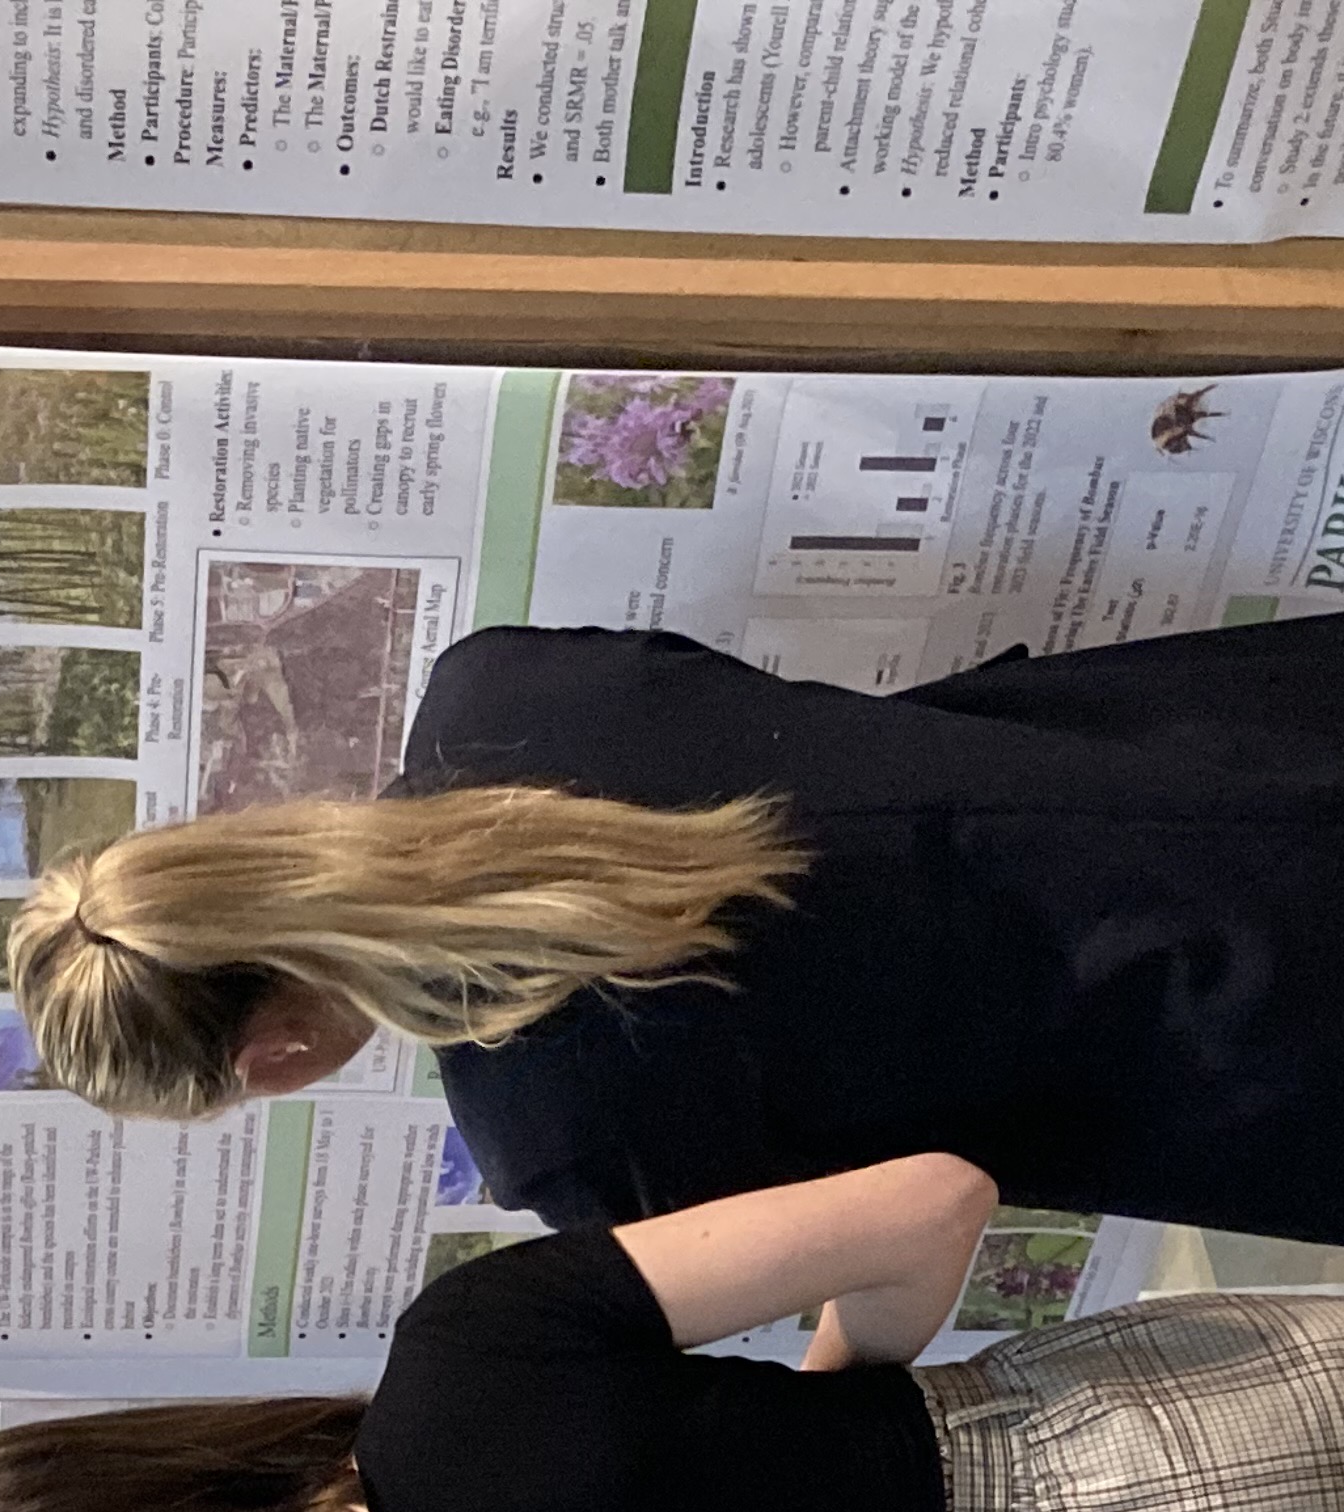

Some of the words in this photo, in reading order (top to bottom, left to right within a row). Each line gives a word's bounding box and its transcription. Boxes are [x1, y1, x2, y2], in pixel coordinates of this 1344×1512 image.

[11, 31, 27, 46] to
[43, 26, 61, 36] It
[45, 8, 62, 20] is
[413, 28, 428, 42] to
[607, 23, 626, 52] talk
[731, 4, 756, 53] shown
[899, 5, 920, 28] the
[75, 20, 96, 102] disordered
[407, 47, 427, 75] like
[478, 50, 494, 74] am
[896, 31, 914, 49] of
[919, 52, 940, 76] We
[9, 52, 32, 137] expanding
[536, 42, 560, 125] conducted
[564, 66, 588, 123] SRMR
[602, 56, 621, 114] mother
[725, 59, 745, 84] has
[887, 54, 909, 101] model
[206, 71, 227, 167] Measures:
[239, 48, 262, 147] Predictors:
[272, 95, 291, 127] The
[305, 96, 324, 129] The
[336, 55, 361, 152] Outcomes:
[369, 78, 391, 132] Dutch
[405, 80, 423, 133] would
[435, 75, 461, 134] Eating
[747, 73, 776, 170] adolescents
[778, 72, 810, 150] However,
[814, 56, 843, 153] parent-child
[840, 78, 872, 173] Attachment
[857, 26, 887, 73] theory
[934, 112, 958, 177] reduced
[948, 37, 978, 107] relational
[1018, 125, 1042, 161] Intro
[1033, 34, 1071, 119] psychology
[76, 108, 93, 139] and
[107, 89, 126, 162] Method
[496, 109, 517, 180] Results
[529, 131, 548, 160] We
[563, 129, 581, 162] and
[593, 120, 614, 162] Both
[685, 71, 715, 187] Introduction
[713, 89, 740, 168] Research
[873, 105, 901, 174] working
[1045, 114, 1072, 162] 80.4%
[958, 128, 986, 197] Method
[239, 382, 260, 434] invasive
[293, 408, 310, 450] native
[320, 416, 336, 435] for
[375, 401, 391, 414] in
[401, 399, 417, 442] recruit
[426, 383, 447, 428] flowers
[375, 419, 392, 450] gaps
[398, 447, 412, 460] to
[424, 433, 445, 476] spring
[154, 444, 171, 480] Phase
[209, 438, 228, 522] Restoration
[235, 439, 260, 511] Removing
[287, 455, 311, 513] Planting
[318, 441, 336, 514] vegetation
[340, 439, 361, 515] pollinators
[366, 455, 390, 515] Creating
[264, 463, 282, 513] species
[396, 466, 415, 515] canopy
[419, 481, 439, 516] early
[1263, 490, 1308, 586] UNIVERSITY
[1297, 463, 1319, 486] OF
[655, 538, 674, 590] concern
[424, 584, 447, 612] Map
[149, 611, 165, 643] Phase
[420, 616, 439, 652] Aerial
[145, 714, 161, 743] Phase
[258, 1286, 279, 1338] Methods
